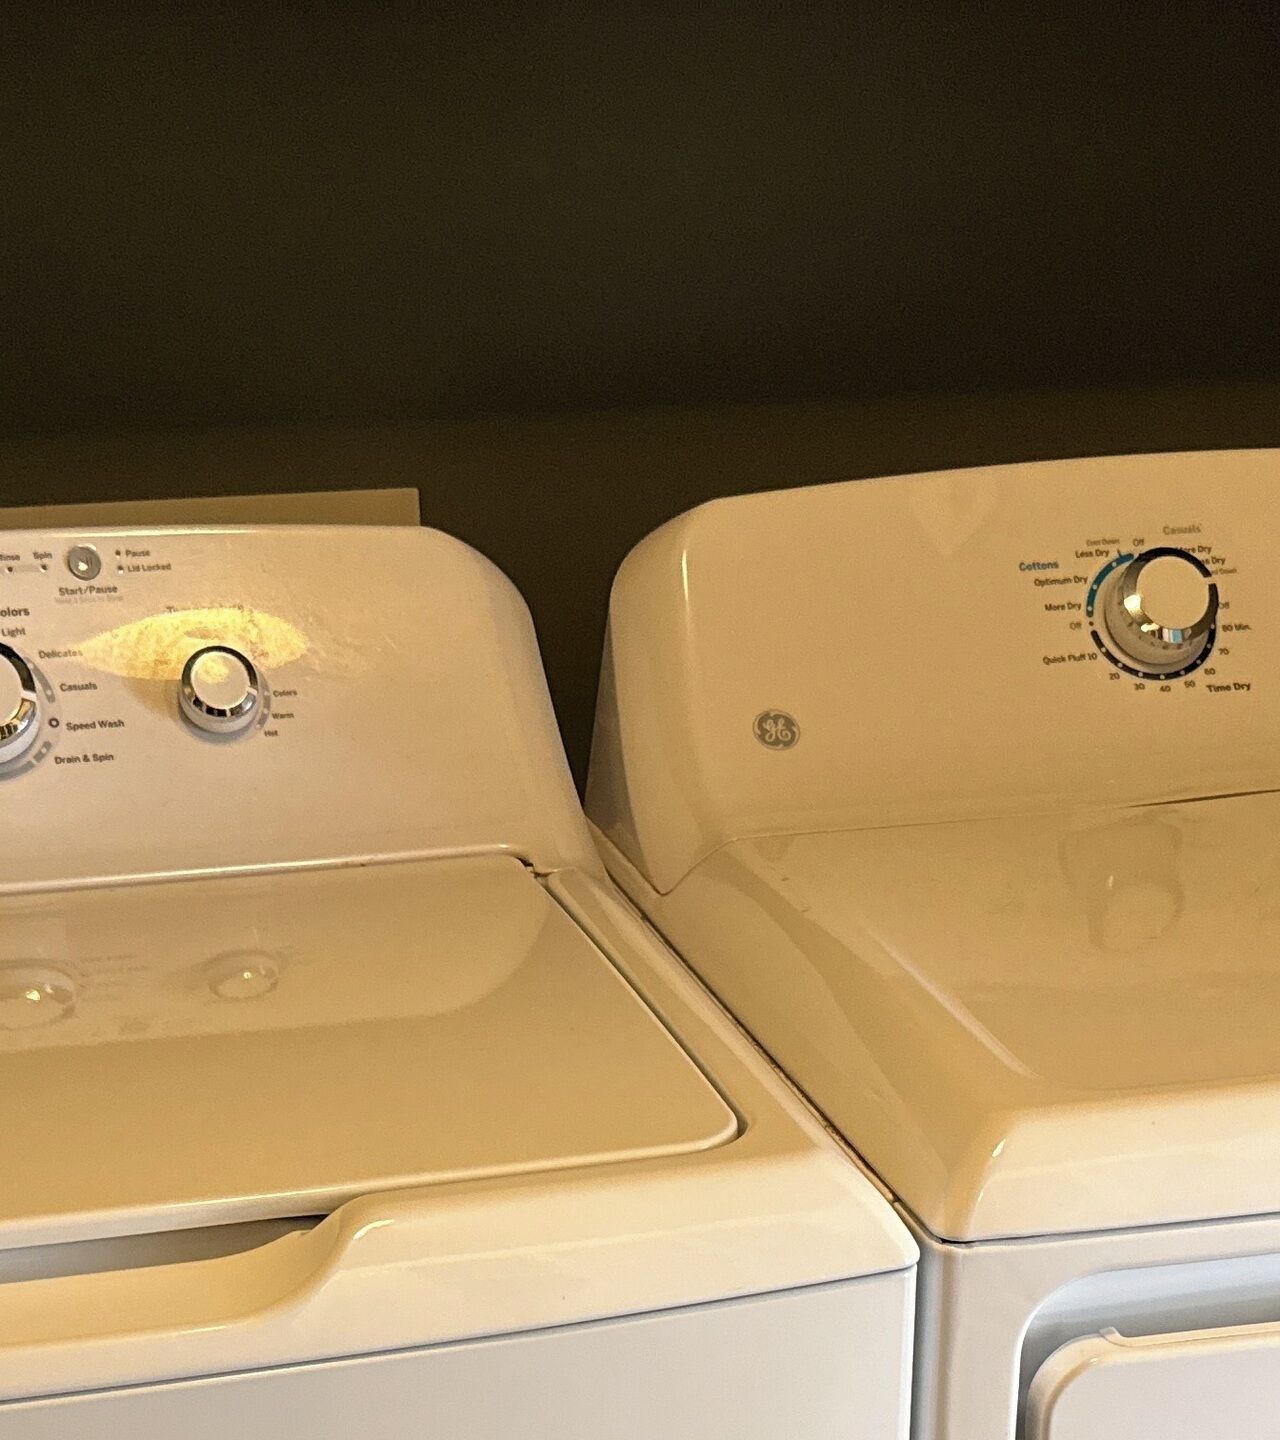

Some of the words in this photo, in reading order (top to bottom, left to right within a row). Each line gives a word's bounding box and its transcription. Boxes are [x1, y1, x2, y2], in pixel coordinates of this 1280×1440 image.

[125, 549, 150, 557] Pause
[1075, 550, 1093, 558] Less
[1095, 549, 1109, 558] Dry
[1198, 546, 1212, 554] Dry
[33, 551, 53, 560] Spin
[1019, 562, 1059, 571] Cottons
[1073, 576, 1088, 585] Dry
[58, 585, 118, 596] Start/Pause
[1045, 603, 1066, 611] More
[1067, 602, 1081, 610] Dry
[1, 627, 26, 638] Light
[1042, 656, 1067, 665] Quick
[1087, 652, 1098, 660] 10
[1109, 672, 1120, 680] 20
[1206, 684, 1231, 693] Time
[1233, 682, 1251, 692] Dry
[66, 721, 96, 732] Speed
[98, 720, 125, 729] Wash
[54, 756, 81, 764] Drain
[92, 753, 114, 762] Spin
